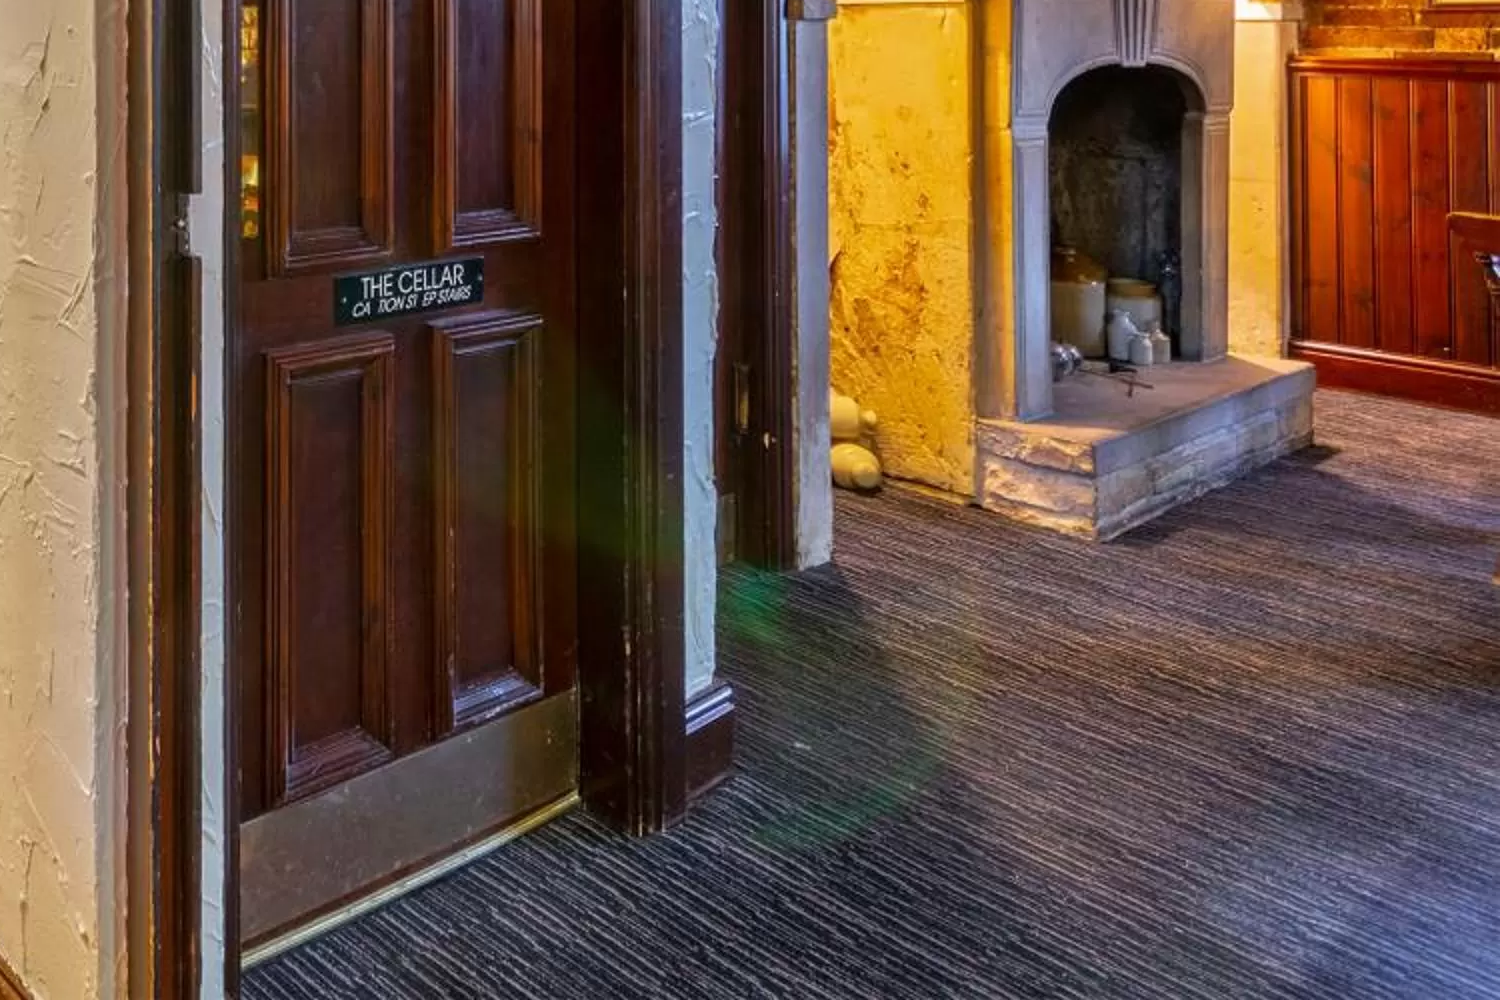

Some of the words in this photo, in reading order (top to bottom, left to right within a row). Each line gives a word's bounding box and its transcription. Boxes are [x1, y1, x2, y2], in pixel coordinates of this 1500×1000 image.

[360, 273, 394, 300] THE
[397, 263, 465, 294] CELLAR
[352, 295, 406, 318] CATION
[405, 291, 437, 309] STEP
[437, 285, 473, 305] STAIRS
